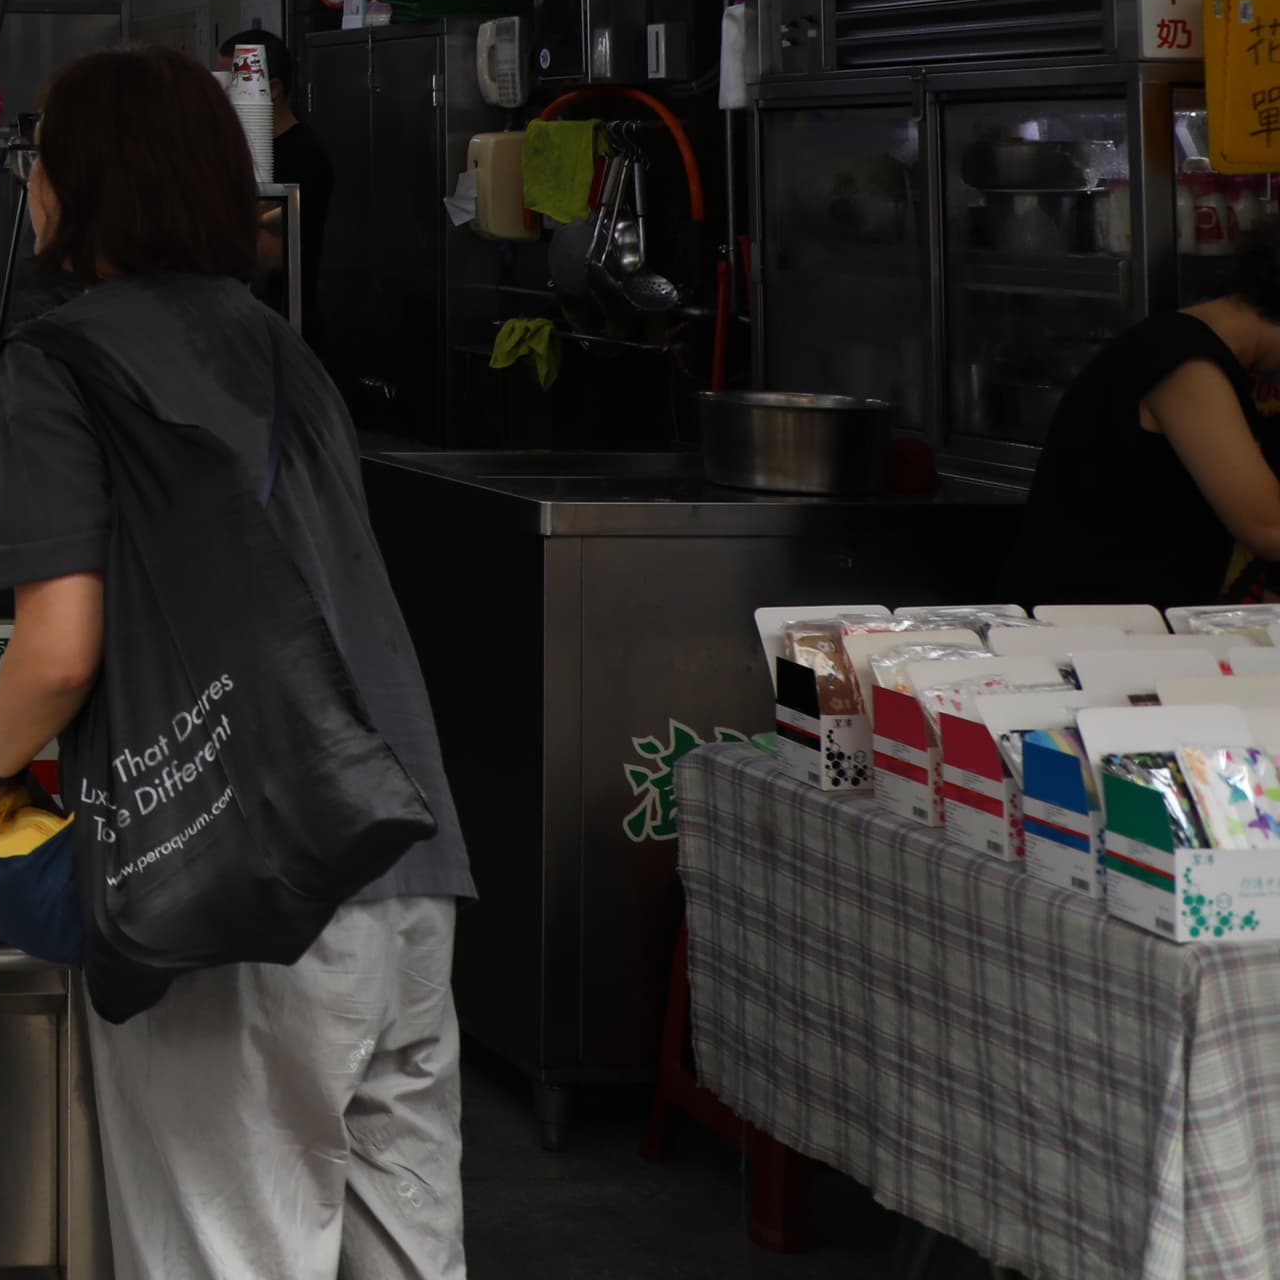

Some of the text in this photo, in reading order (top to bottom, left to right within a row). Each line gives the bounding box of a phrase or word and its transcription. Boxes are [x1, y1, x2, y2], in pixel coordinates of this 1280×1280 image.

[111, 734, 170, 783] That
[171, 673, 234, 744] Dares
[134, 713, 232, 816] Different
